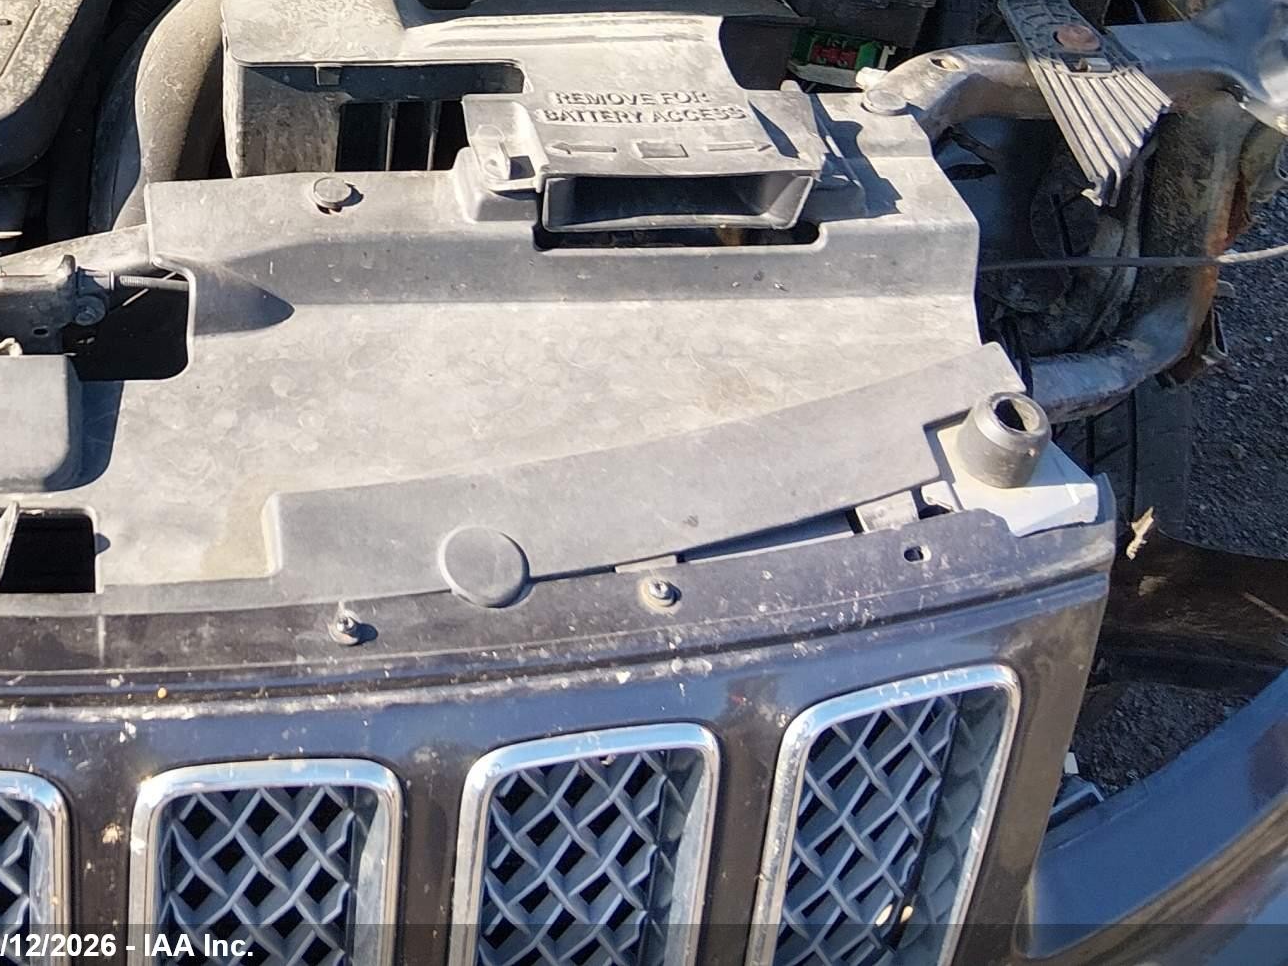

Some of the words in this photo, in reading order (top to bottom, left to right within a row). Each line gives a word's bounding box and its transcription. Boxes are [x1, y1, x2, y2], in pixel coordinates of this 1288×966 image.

[553, 91, 656, 106] REMOVE
[660, 90, 713, 105] FOR
[542, 107, 643, 124] BATTERY
[651, 106, 748, 123] ACCESS
